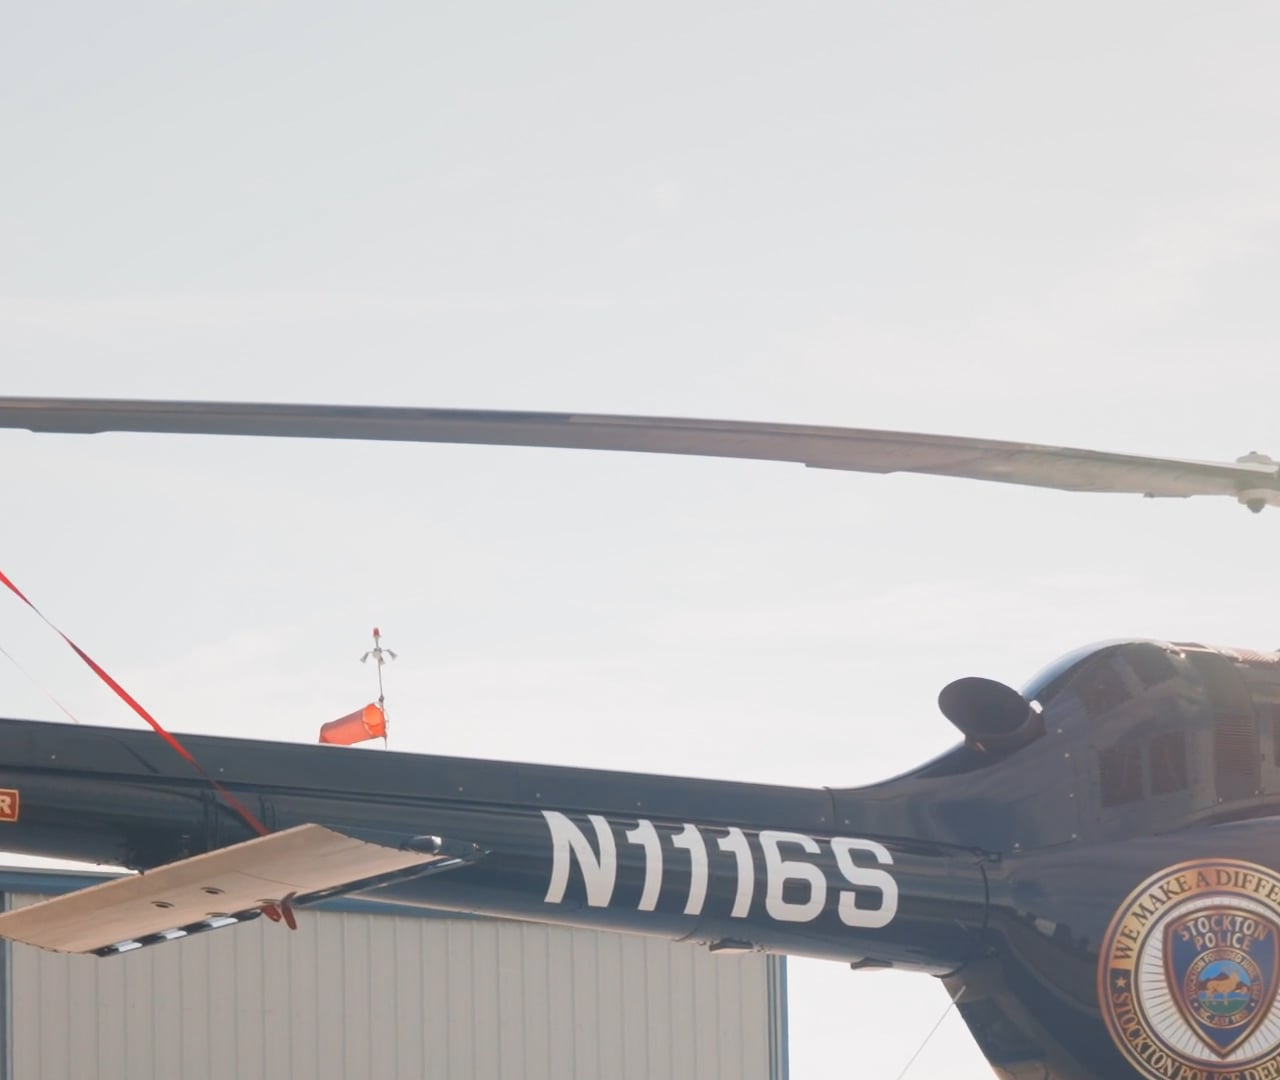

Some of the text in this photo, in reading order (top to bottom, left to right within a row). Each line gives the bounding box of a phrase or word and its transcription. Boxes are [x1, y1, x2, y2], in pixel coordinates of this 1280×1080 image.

[541, 810, 899, 929] N1116S
[1113, 925, 1140, 961] WE
[1131, 874, 1192, 926] MAKE
[1196, 870, 1211, 888] A
[1177, 915, 1268, 942] STOCKTON
[1194, 931, 1251, 950] POLICE
[1112, 992, 1177, 1078] STOCKTON
